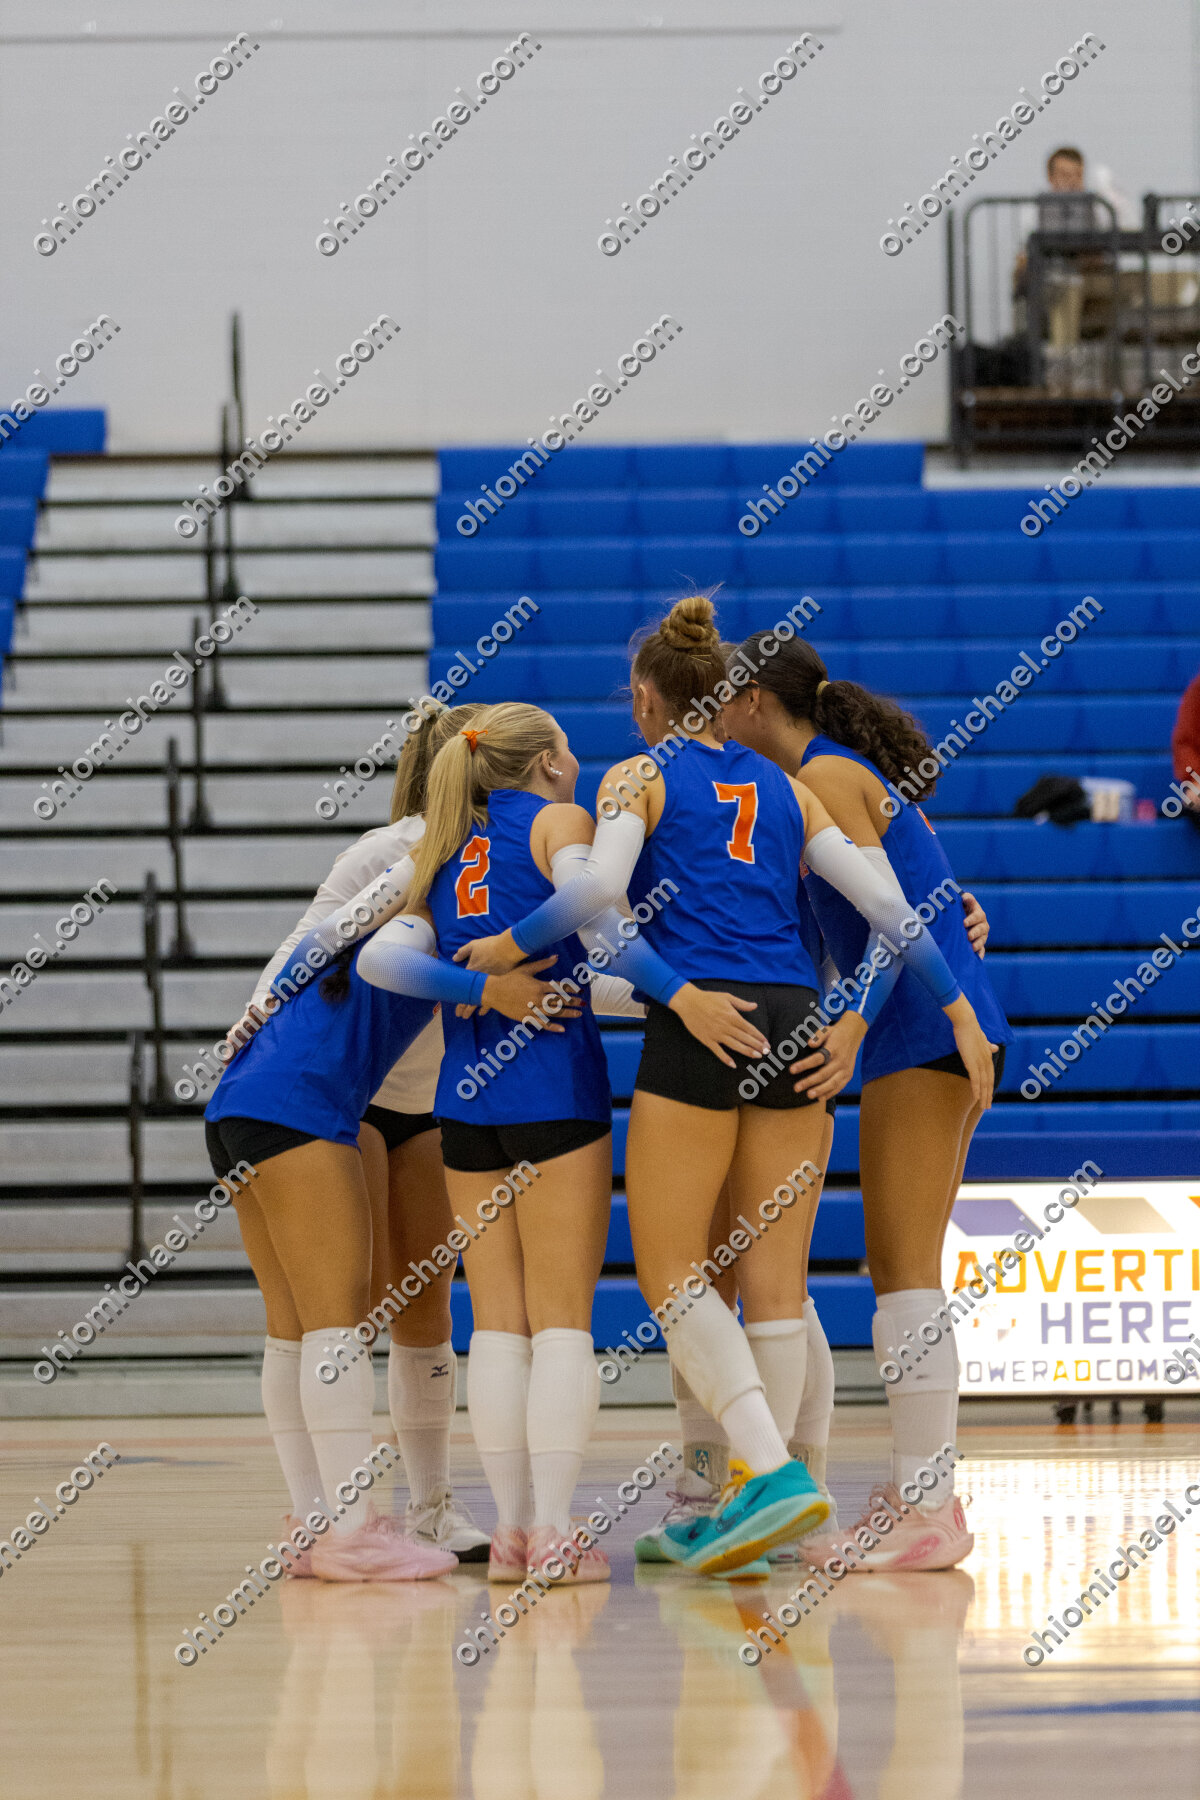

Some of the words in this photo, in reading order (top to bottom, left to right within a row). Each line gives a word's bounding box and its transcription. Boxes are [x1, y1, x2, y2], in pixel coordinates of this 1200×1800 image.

[712, 781, 759, 864] 7
[454, 835, 491, 919] 2
[952, 1249, 1200, 1293] ADVERTI
[1041, 1301, 1192, 1344] HERE
